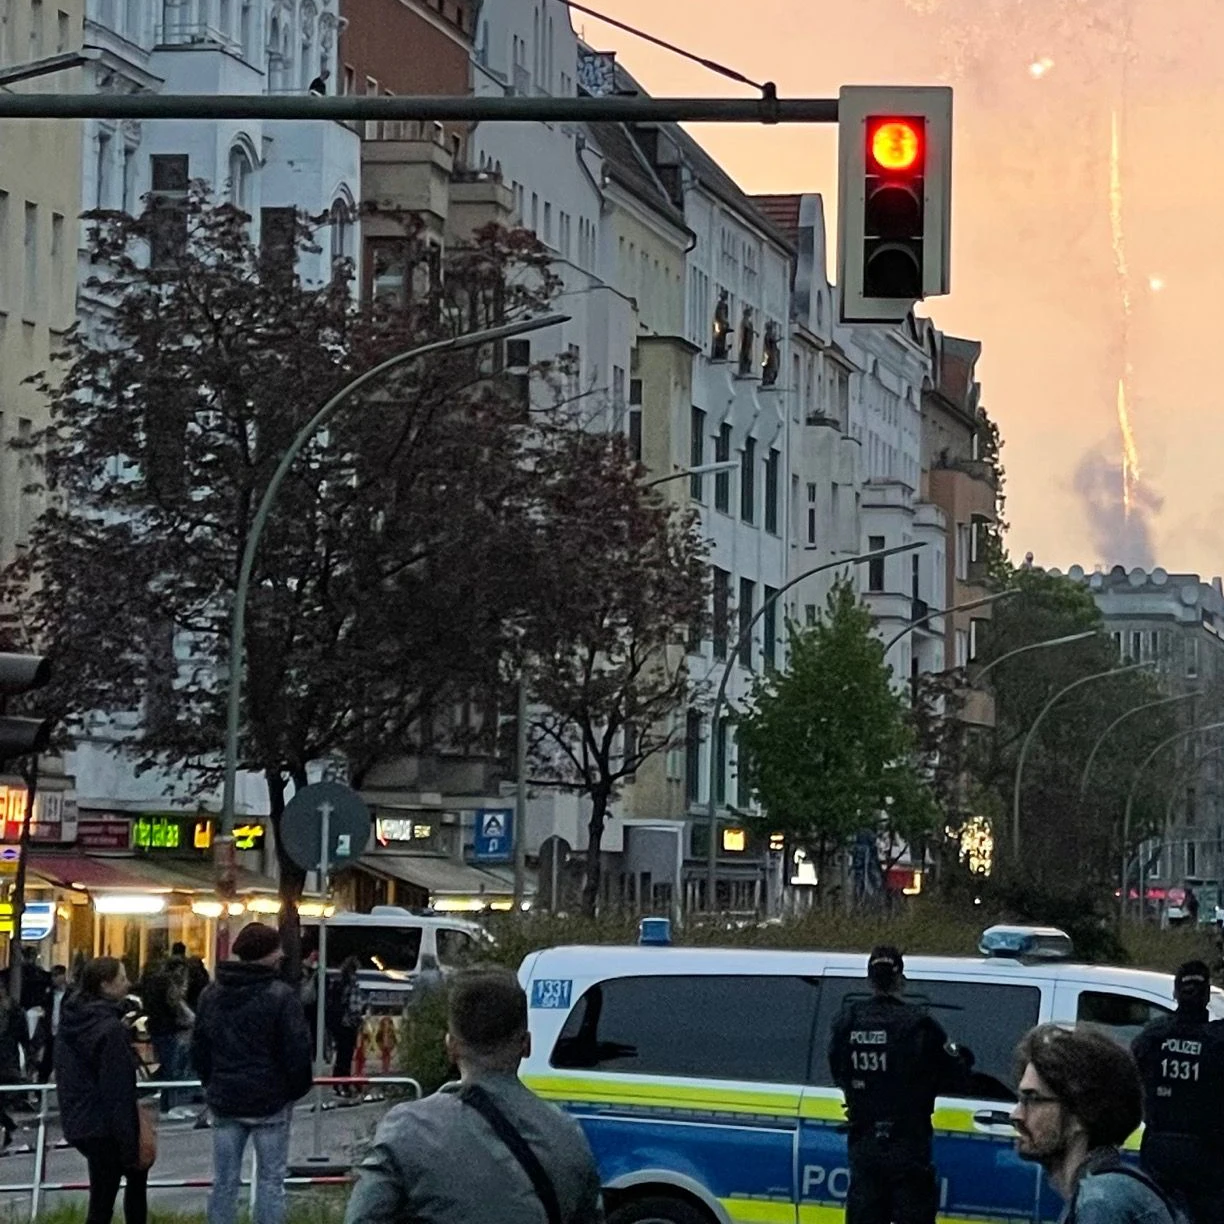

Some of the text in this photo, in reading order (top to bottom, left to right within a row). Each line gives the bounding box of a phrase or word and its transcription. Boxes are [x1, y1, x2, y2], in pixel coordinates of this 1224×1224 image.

[538, 980, 570, 998] 1331
[850, 1030, 887, 1045] POLIZEI
[1161, 1038, 1202, 1055] POLIZEI
[851, 1050, 887, 1071] 1331
[1161, 1058, 1199, 1081] 1331
